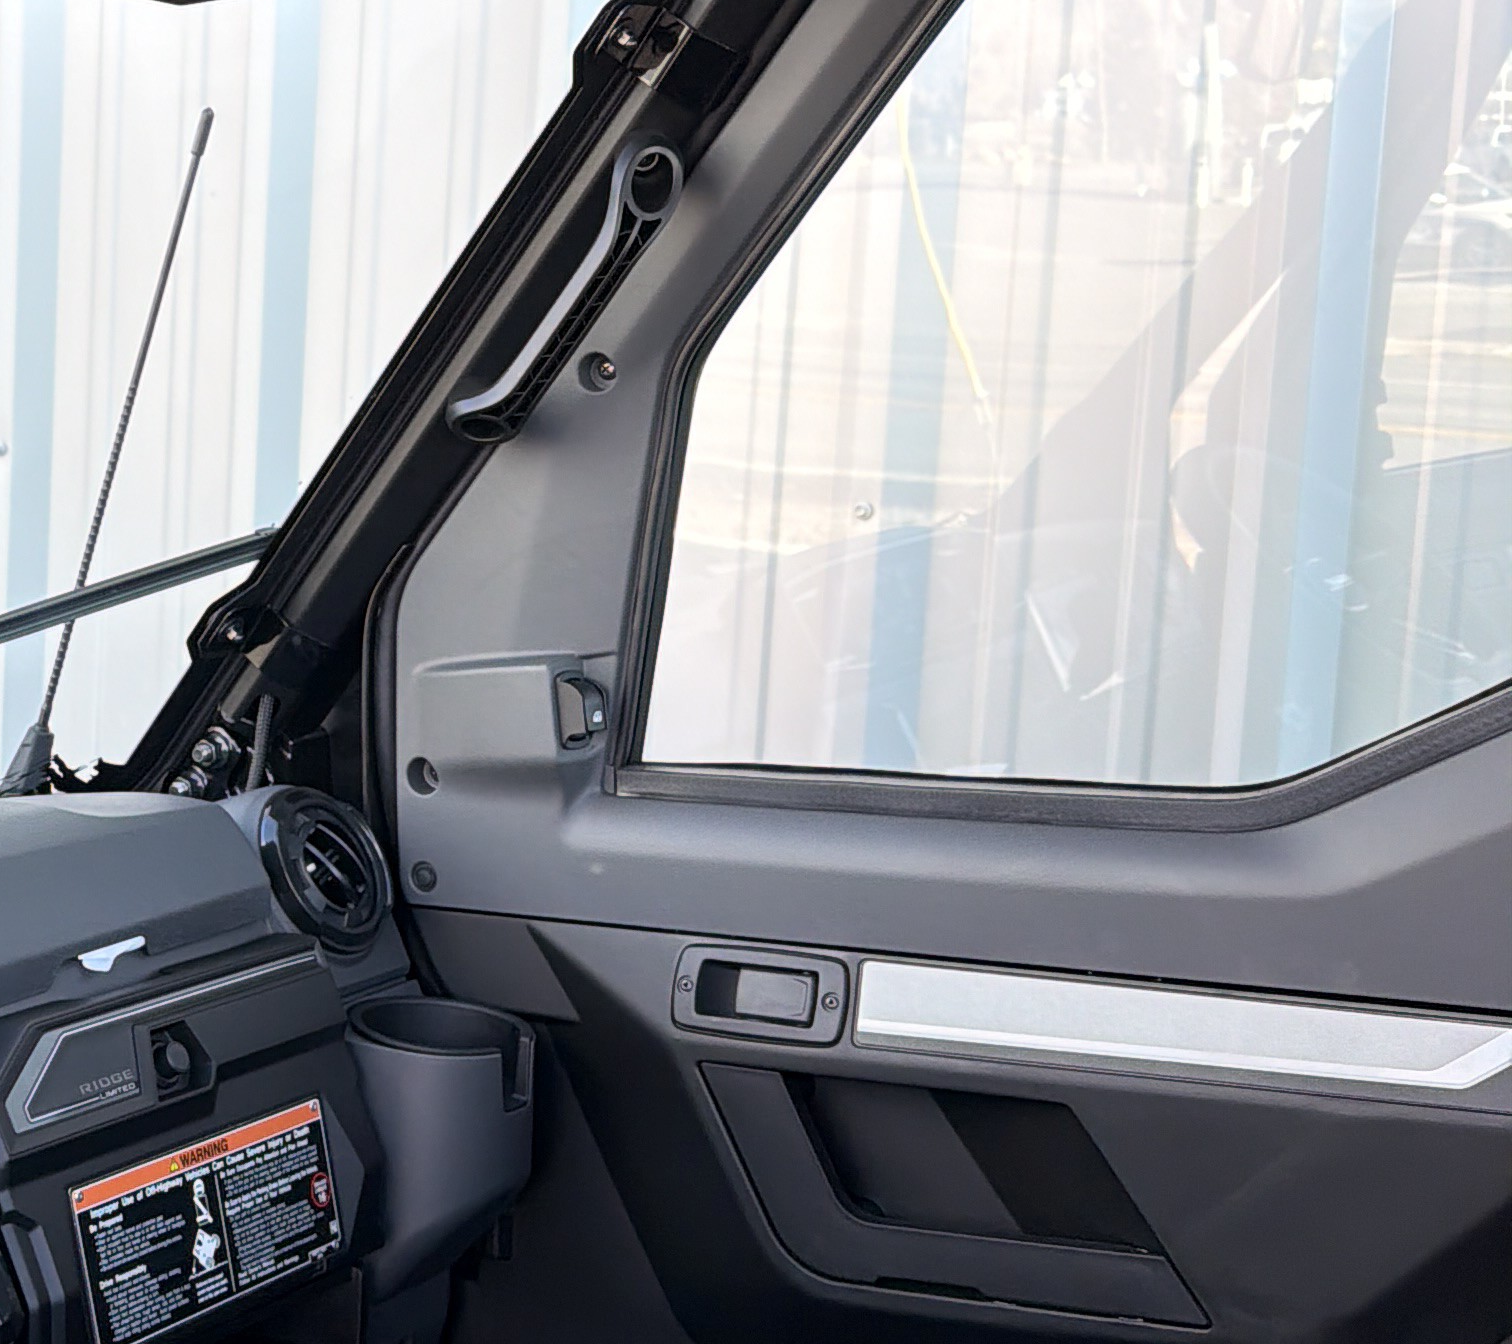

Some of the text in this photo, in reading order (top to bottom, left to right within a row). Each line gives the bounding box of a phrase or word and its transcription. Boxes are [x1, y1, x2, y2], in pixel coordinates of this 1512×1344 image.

[79, 1068, 134, 1095] RIDGE
[100, 1082, 136, 1099] LIMITED
[180, 1138, 228, 1167] WARNING
